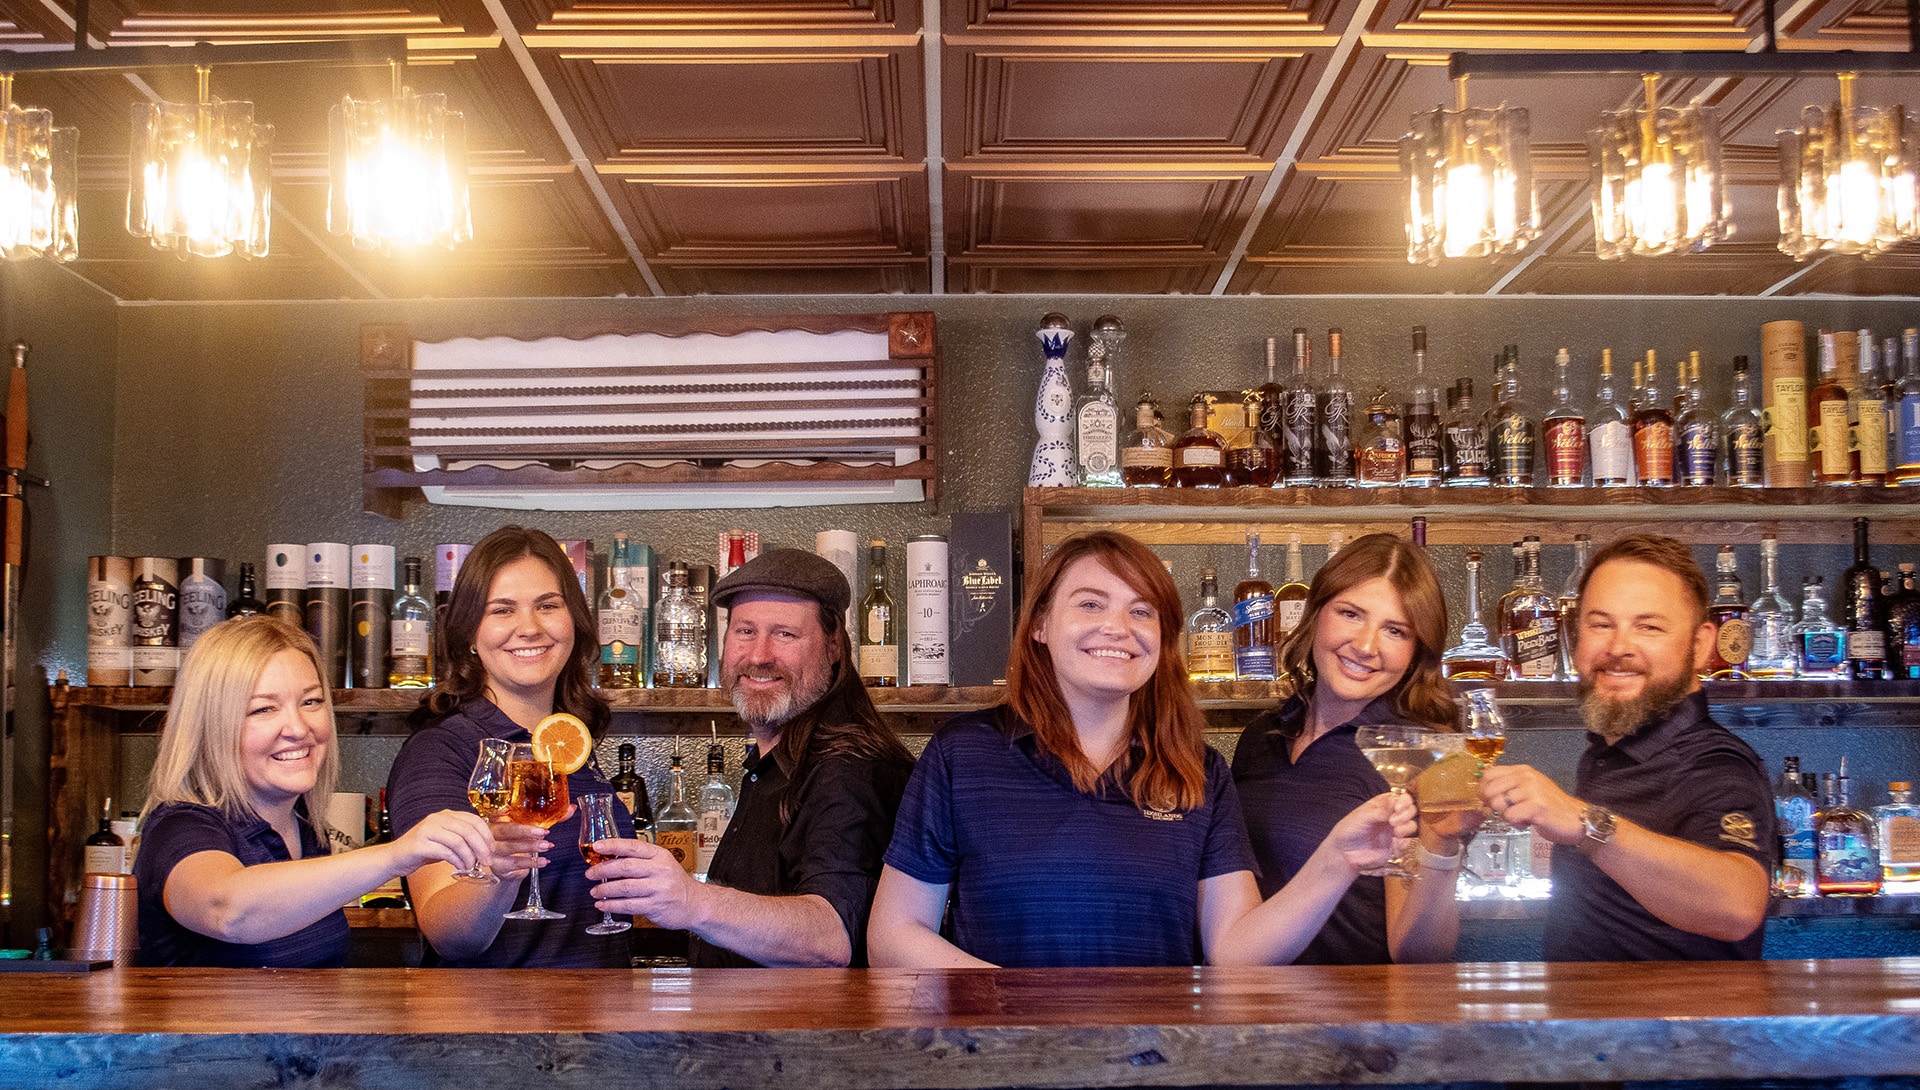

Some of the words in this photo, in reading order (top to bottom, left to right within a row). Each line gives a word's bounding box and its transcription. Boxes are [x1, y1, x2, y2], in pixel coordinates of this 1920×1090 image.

[962, 575, 981, 586] Blue
[88, 590, 130, 610] EELING
[133, 589, 176, 610] EELING
[923, 607, 933, 618] 10
[661, 834, 690, 846] Tito's
